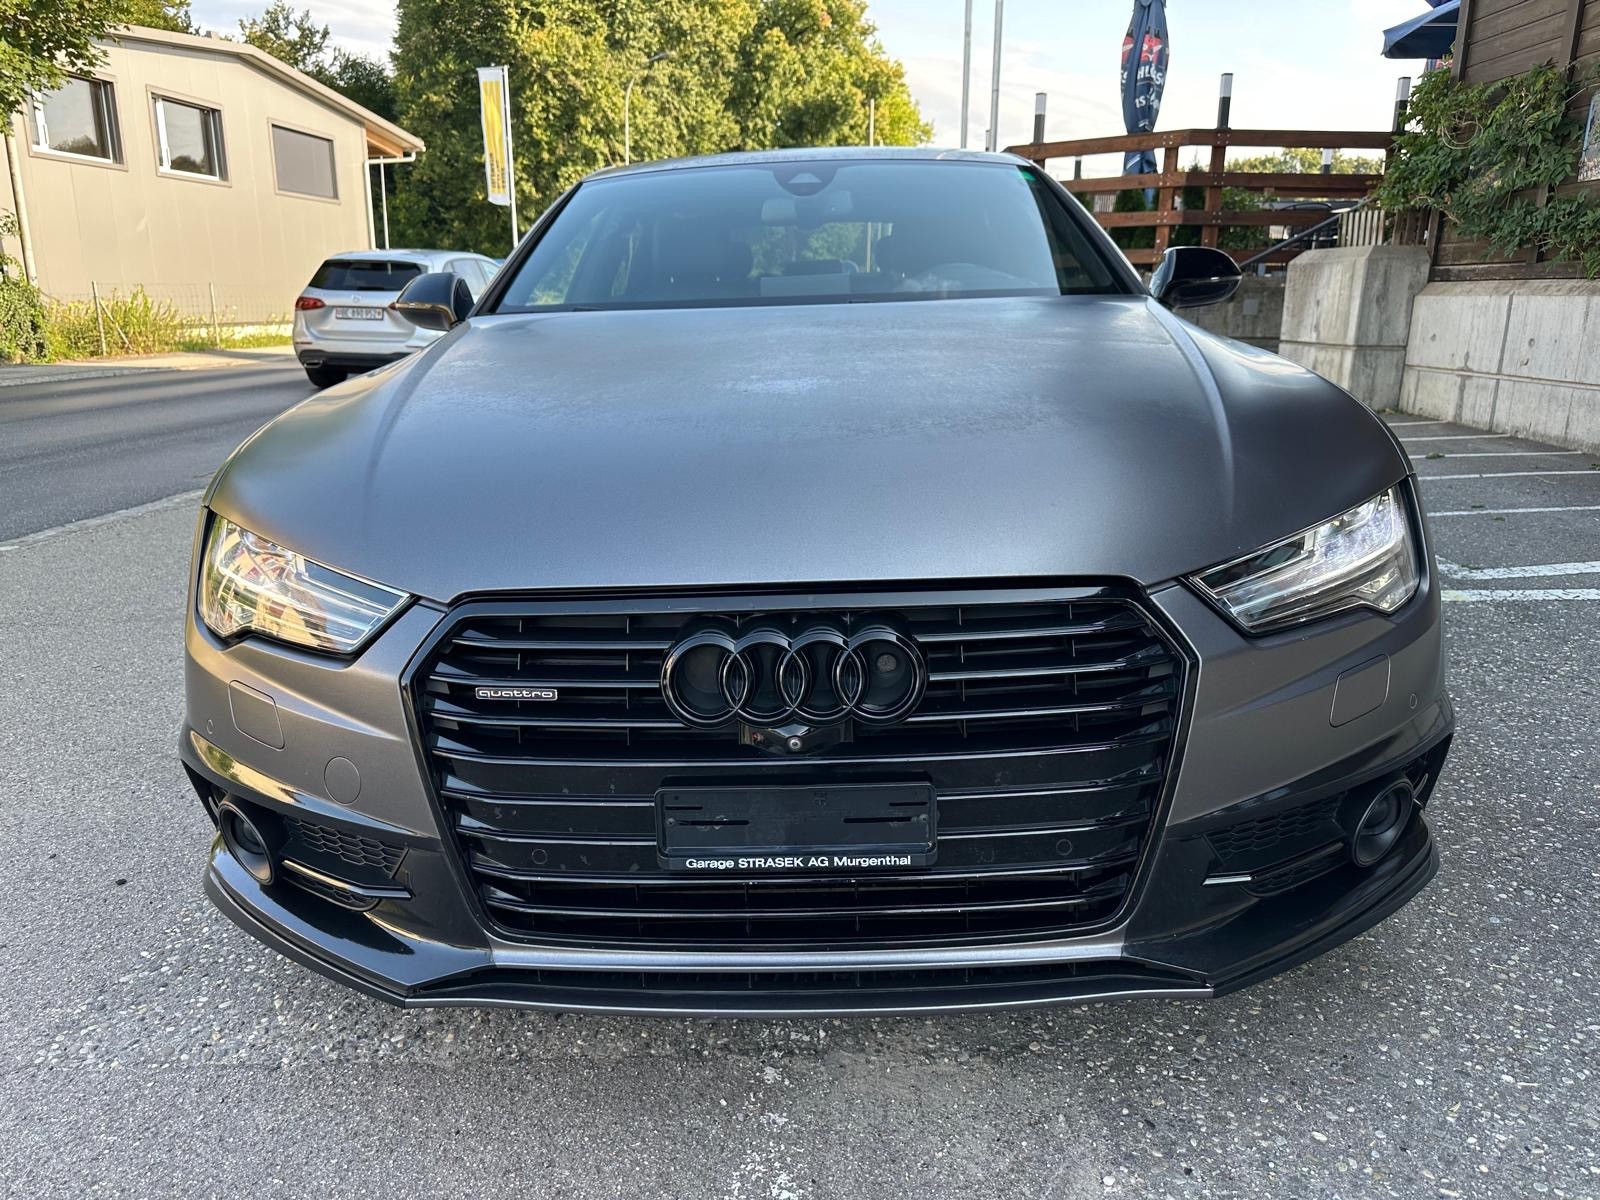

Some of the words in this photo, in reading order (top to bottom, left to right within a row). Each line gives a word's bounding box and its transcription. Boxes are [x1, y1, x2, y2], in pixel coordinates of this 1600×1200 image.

[479, 690, 553, 698] quattro
[685, 858, 735, 870] Garage
[738, 857, 804, 869] STRASEK
[807, 856, 829, 867] AG
[833, 855, 912, 868] Murgenthal
